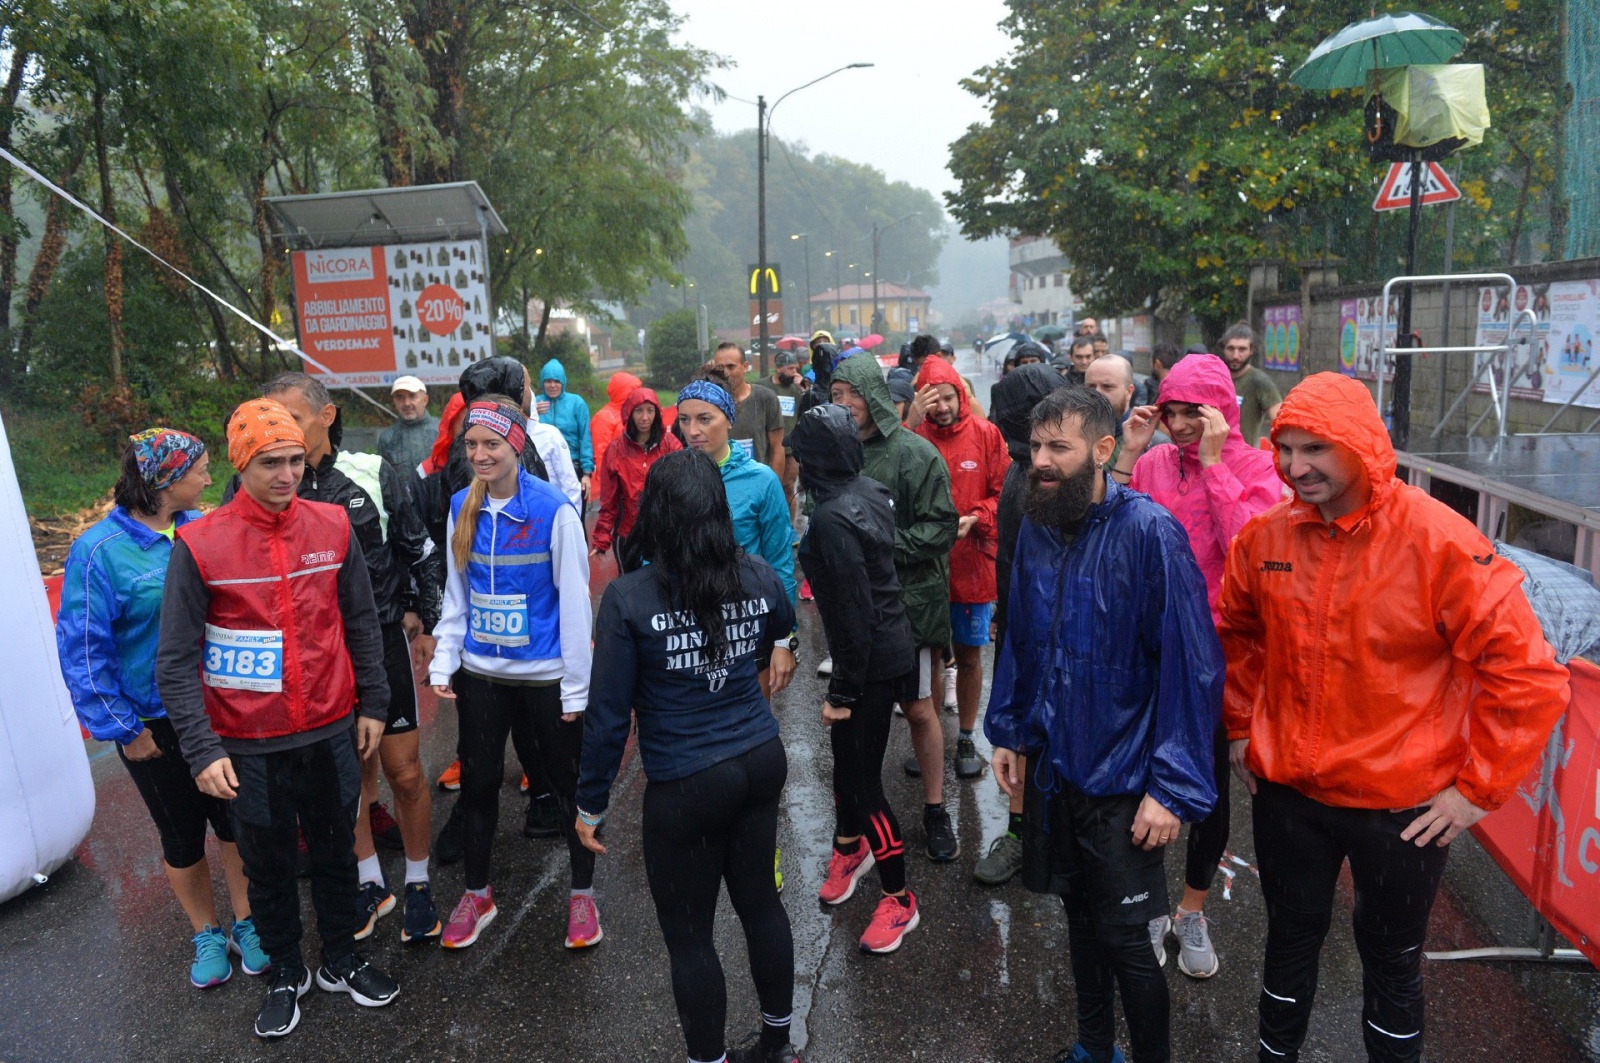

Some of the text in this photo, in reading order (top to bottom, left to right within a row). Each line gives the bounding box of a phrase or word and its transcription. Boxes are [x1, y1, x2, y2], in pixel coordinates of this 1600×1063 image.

[310, 256, 369, 273] NICORA
[304, 297, 386, 317] ABBIGLIAMENTO
[418, 298, 462, 322] -20%
[305, 315, 388, 334] DA GIARDINAGGIO
[313, 338, 380, 351] VERDEMAX
[344, 375, 381, 385] GARDEN
[472, 608, 523, 633] 3190
[235, 635, 263, 643] FAMILY
[262, 635, 278, 645] RUN
[206, 646, 276, 676] 3183
[705, 668, 729, 681] 1978
[1131, 891, 1150, 904] ABC
